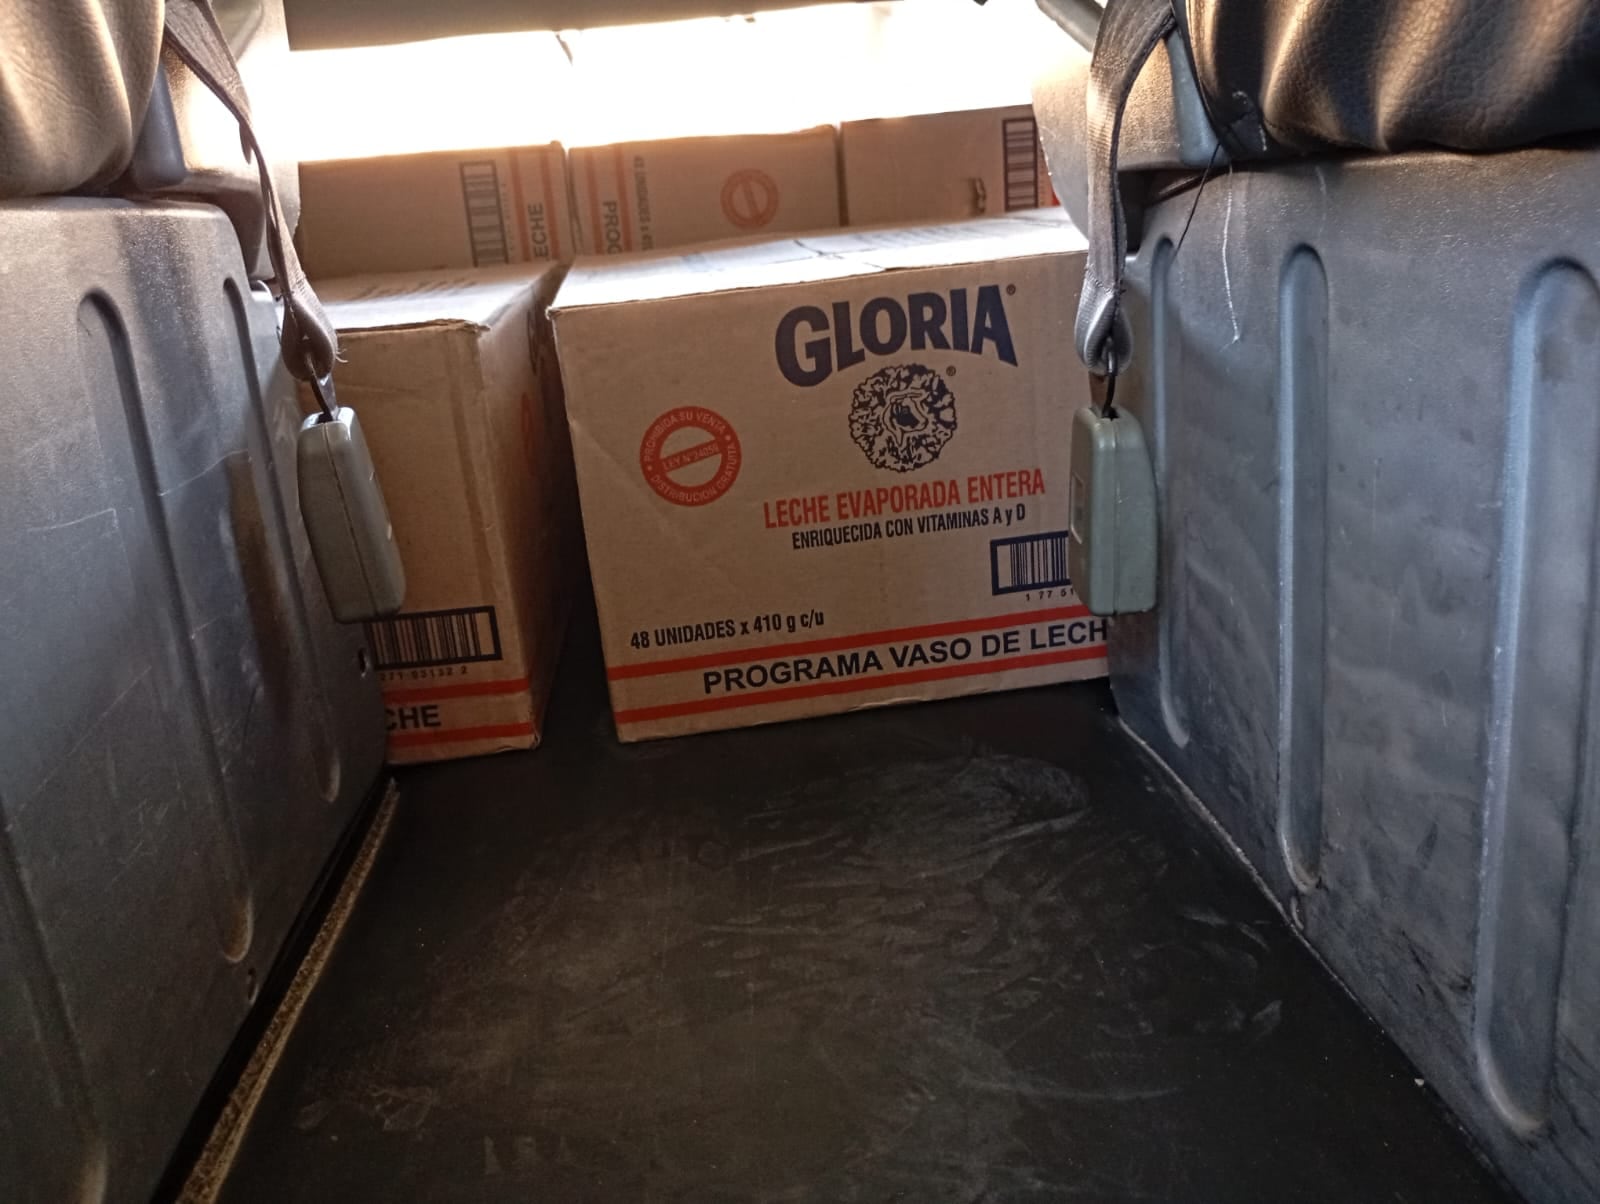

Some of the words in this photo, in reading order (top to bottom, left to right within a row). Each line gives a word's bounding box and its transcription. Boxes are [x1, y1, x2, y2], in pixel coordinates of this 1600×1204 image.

[527, 202, 550, 261] ECHE
[775, 284, 1018, 387] GLORIA
[643, 415, 678, 462] PROHIBIDA
[679, 411, 693, 421] SU
[696, 412, 727, 435] VENTA
[661, 455, 681, 470] LEY
[716, 442, 738, 490] GRATUITA
[764, 495, 831, 529] LECHE
[836, 479, 961, 521] EVAPORADA
[967, 468, 1046, 503] ENTERA
[792, 525, 882, 550] ENRIQUECIDA
[886, 518, 914, 537] CON
[917, 509, 989, 534] VITAMINAS
[992, 507, 1003, 524] A
[1005, 510, 1014, 526] y
[1016, 503, 1026, 520] D
[630, 630, 650, 649] 48
[654, 619, 736, 647] UNIDADES
[740, 621, 750, 636] x
[753, 613, 782, 633] 410
[786, 617, 796, 632] g
[800, 609, 824, 629] c/u
[703, 650, 884, 694] PROGRAMA
[889, 637, 972, 668] VASO
[981, 630, 1021, 657] DE
[1030, 621, 1108, 650] LECH
